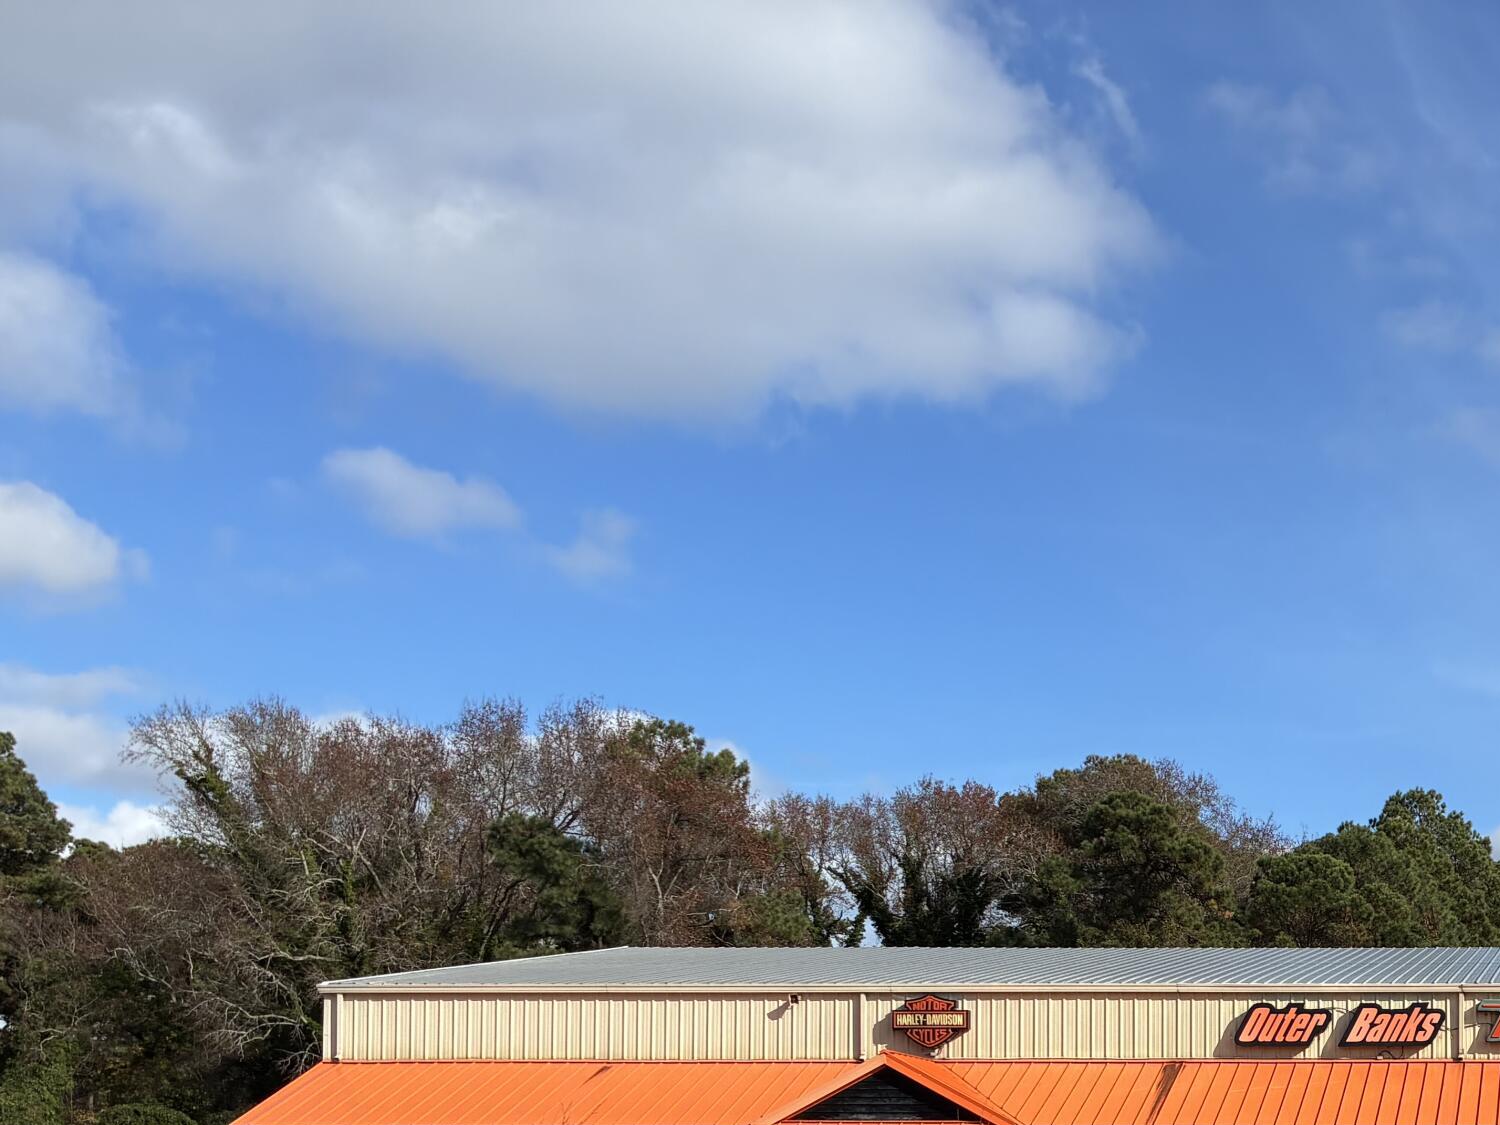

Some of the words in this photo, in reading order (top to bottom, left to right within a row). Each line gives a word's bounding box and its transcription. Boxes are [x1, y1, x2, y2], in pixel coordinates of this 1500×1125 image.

[912, 999, 948, 1011] MOTOR
[896, 1013, 964, 1026] HARLEY-DAVIDSON
[1238, 1006, 1328, 1043] Outer
[1345, 1006, 1443, 1043] Banks
[912, 1028, 948, 1044] CYCLES
